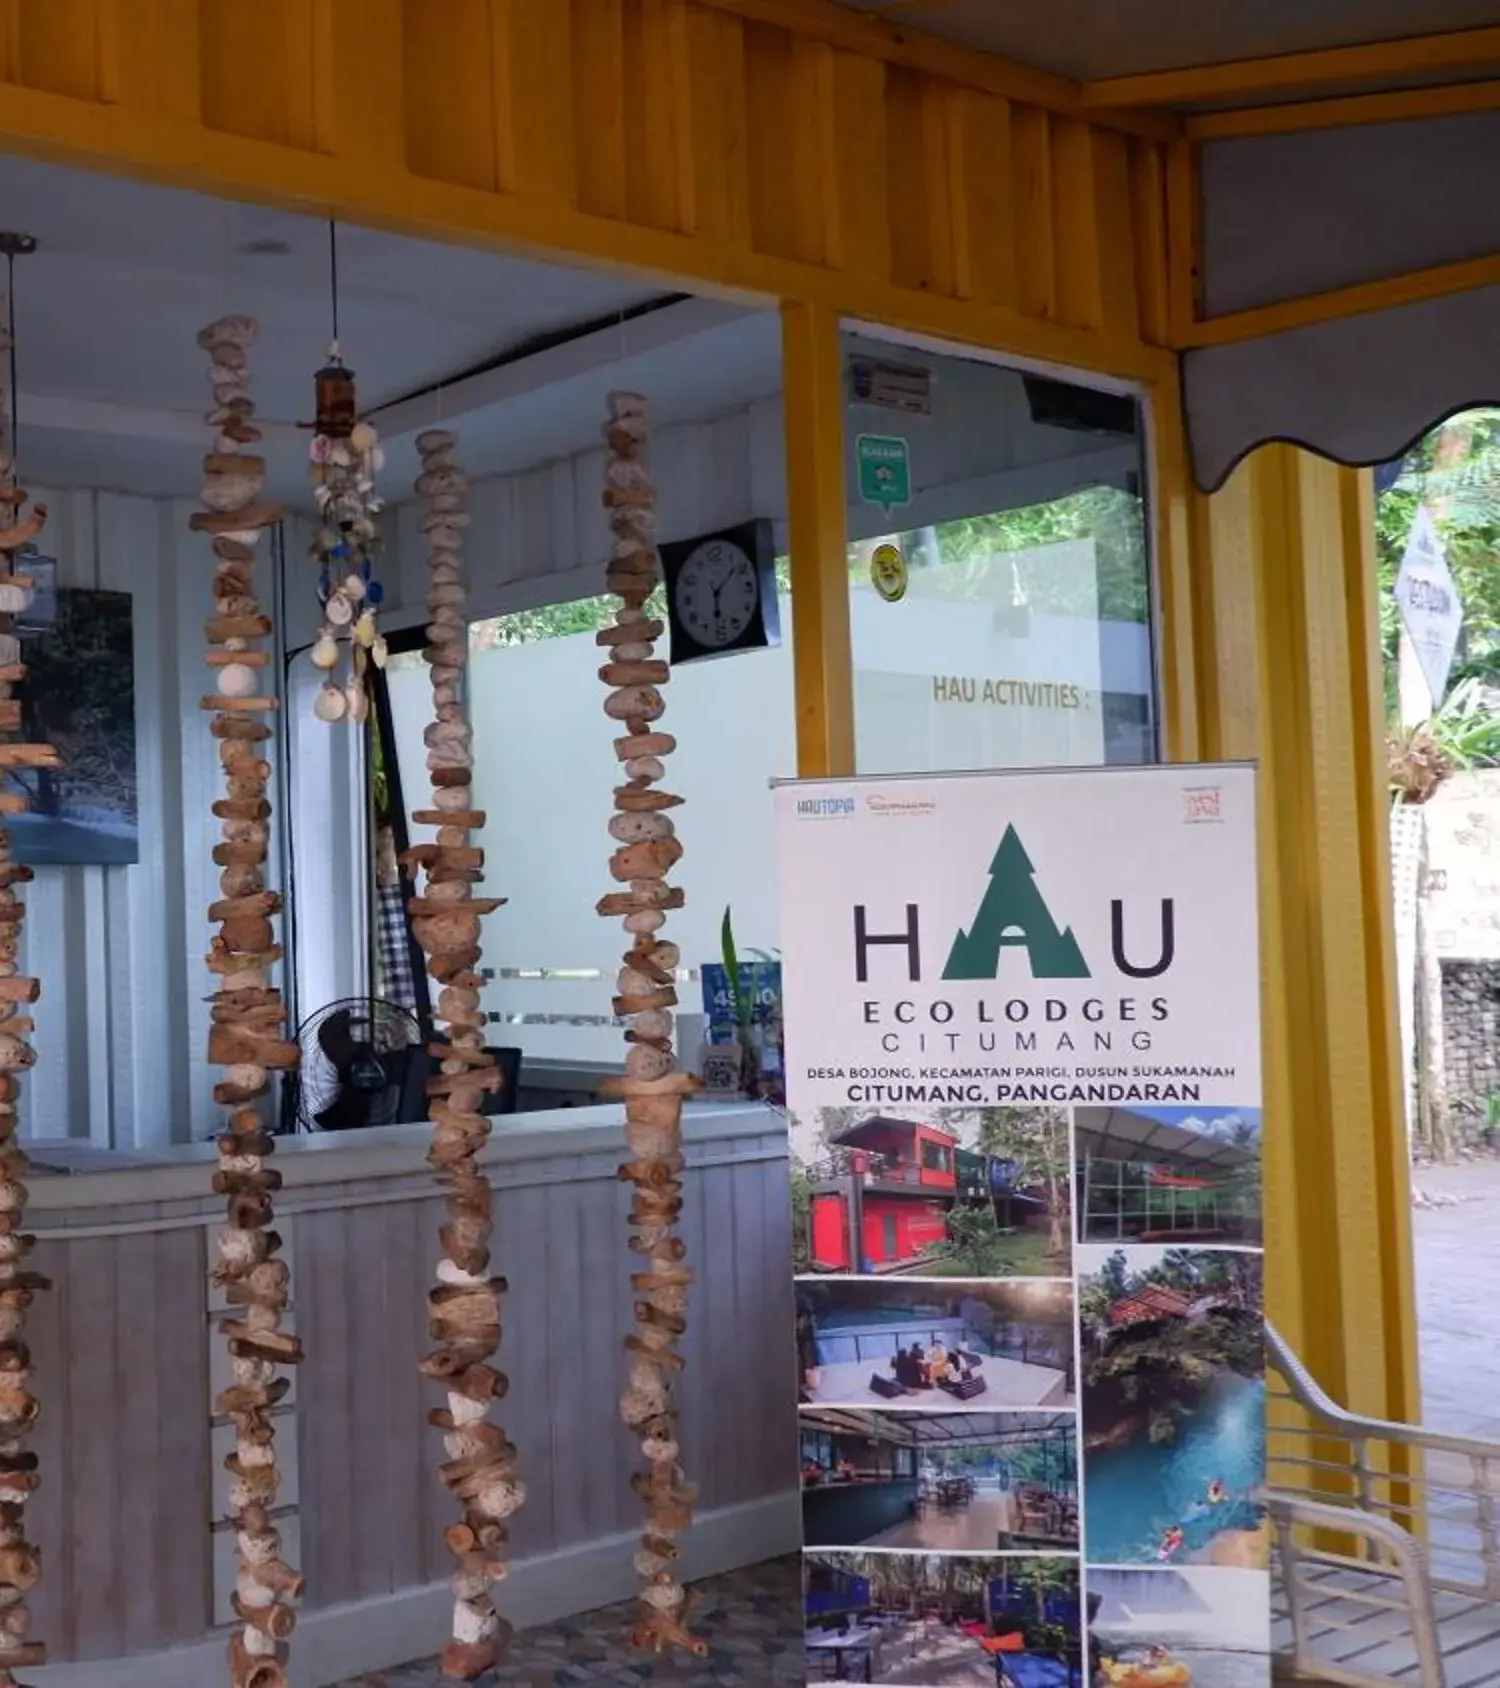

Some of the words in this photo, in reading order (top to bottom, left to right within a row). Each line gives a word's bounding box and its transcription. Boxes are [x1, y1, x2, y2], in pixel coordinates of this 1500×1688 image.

[933, 675, 975, 703] HAU
[853, 821, 1175, 983] HAU
[863, 1000, 955, 1024] ECO
[977, 997, 1169, 1023] LODGES
[881, 1031, 1152, 1053] CITUMANG
[807, 1067, 845, 1079] DESA
[919, 1067, 1011, 1079] KECAMATAN
[1075, 1066, 1128, 1078] DUSUN
[1132, 1065, 1235, 1078] SUKAMANAH
[847, 1084, 989, 1103] CITUMANG,
[997, 1083, 1200, 1102] PANGANDARAN
